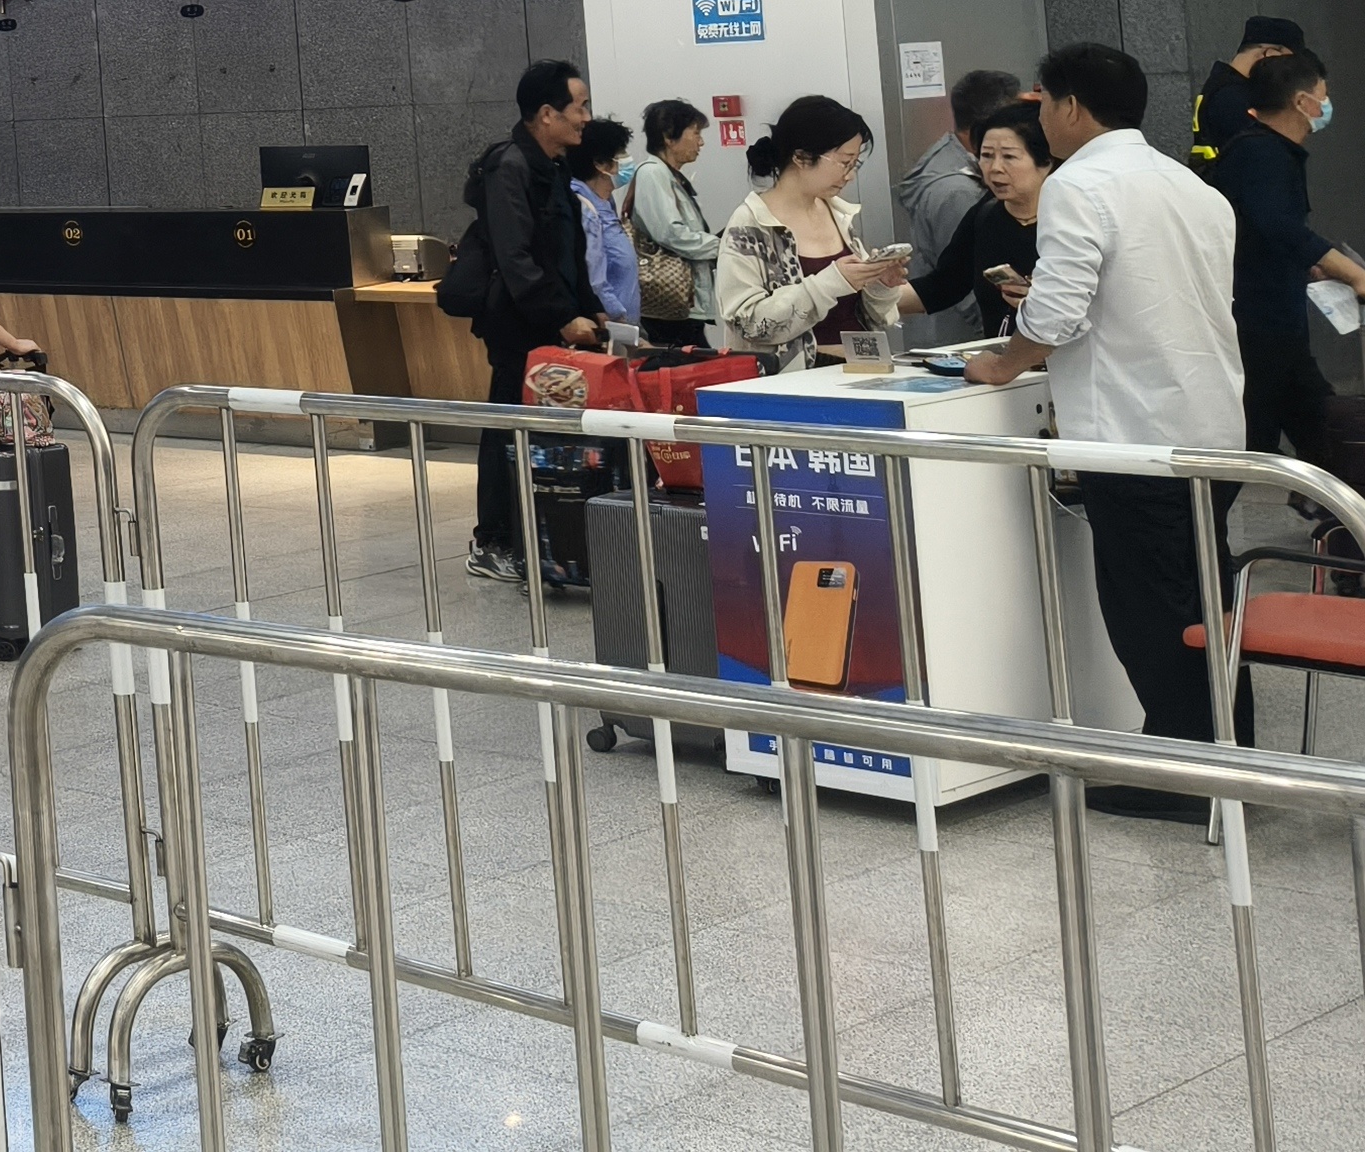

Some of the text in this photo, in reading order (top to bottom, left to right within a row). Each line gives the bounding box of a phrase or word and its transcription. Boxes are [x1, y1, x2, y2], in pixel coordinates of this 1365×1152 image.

[697, 20, 762, 39] 免费无线上网
[65, 227, 81, 239] 02
[236, 228, 253, 240] 01
[811, 495, 870, 515] 不限流量
